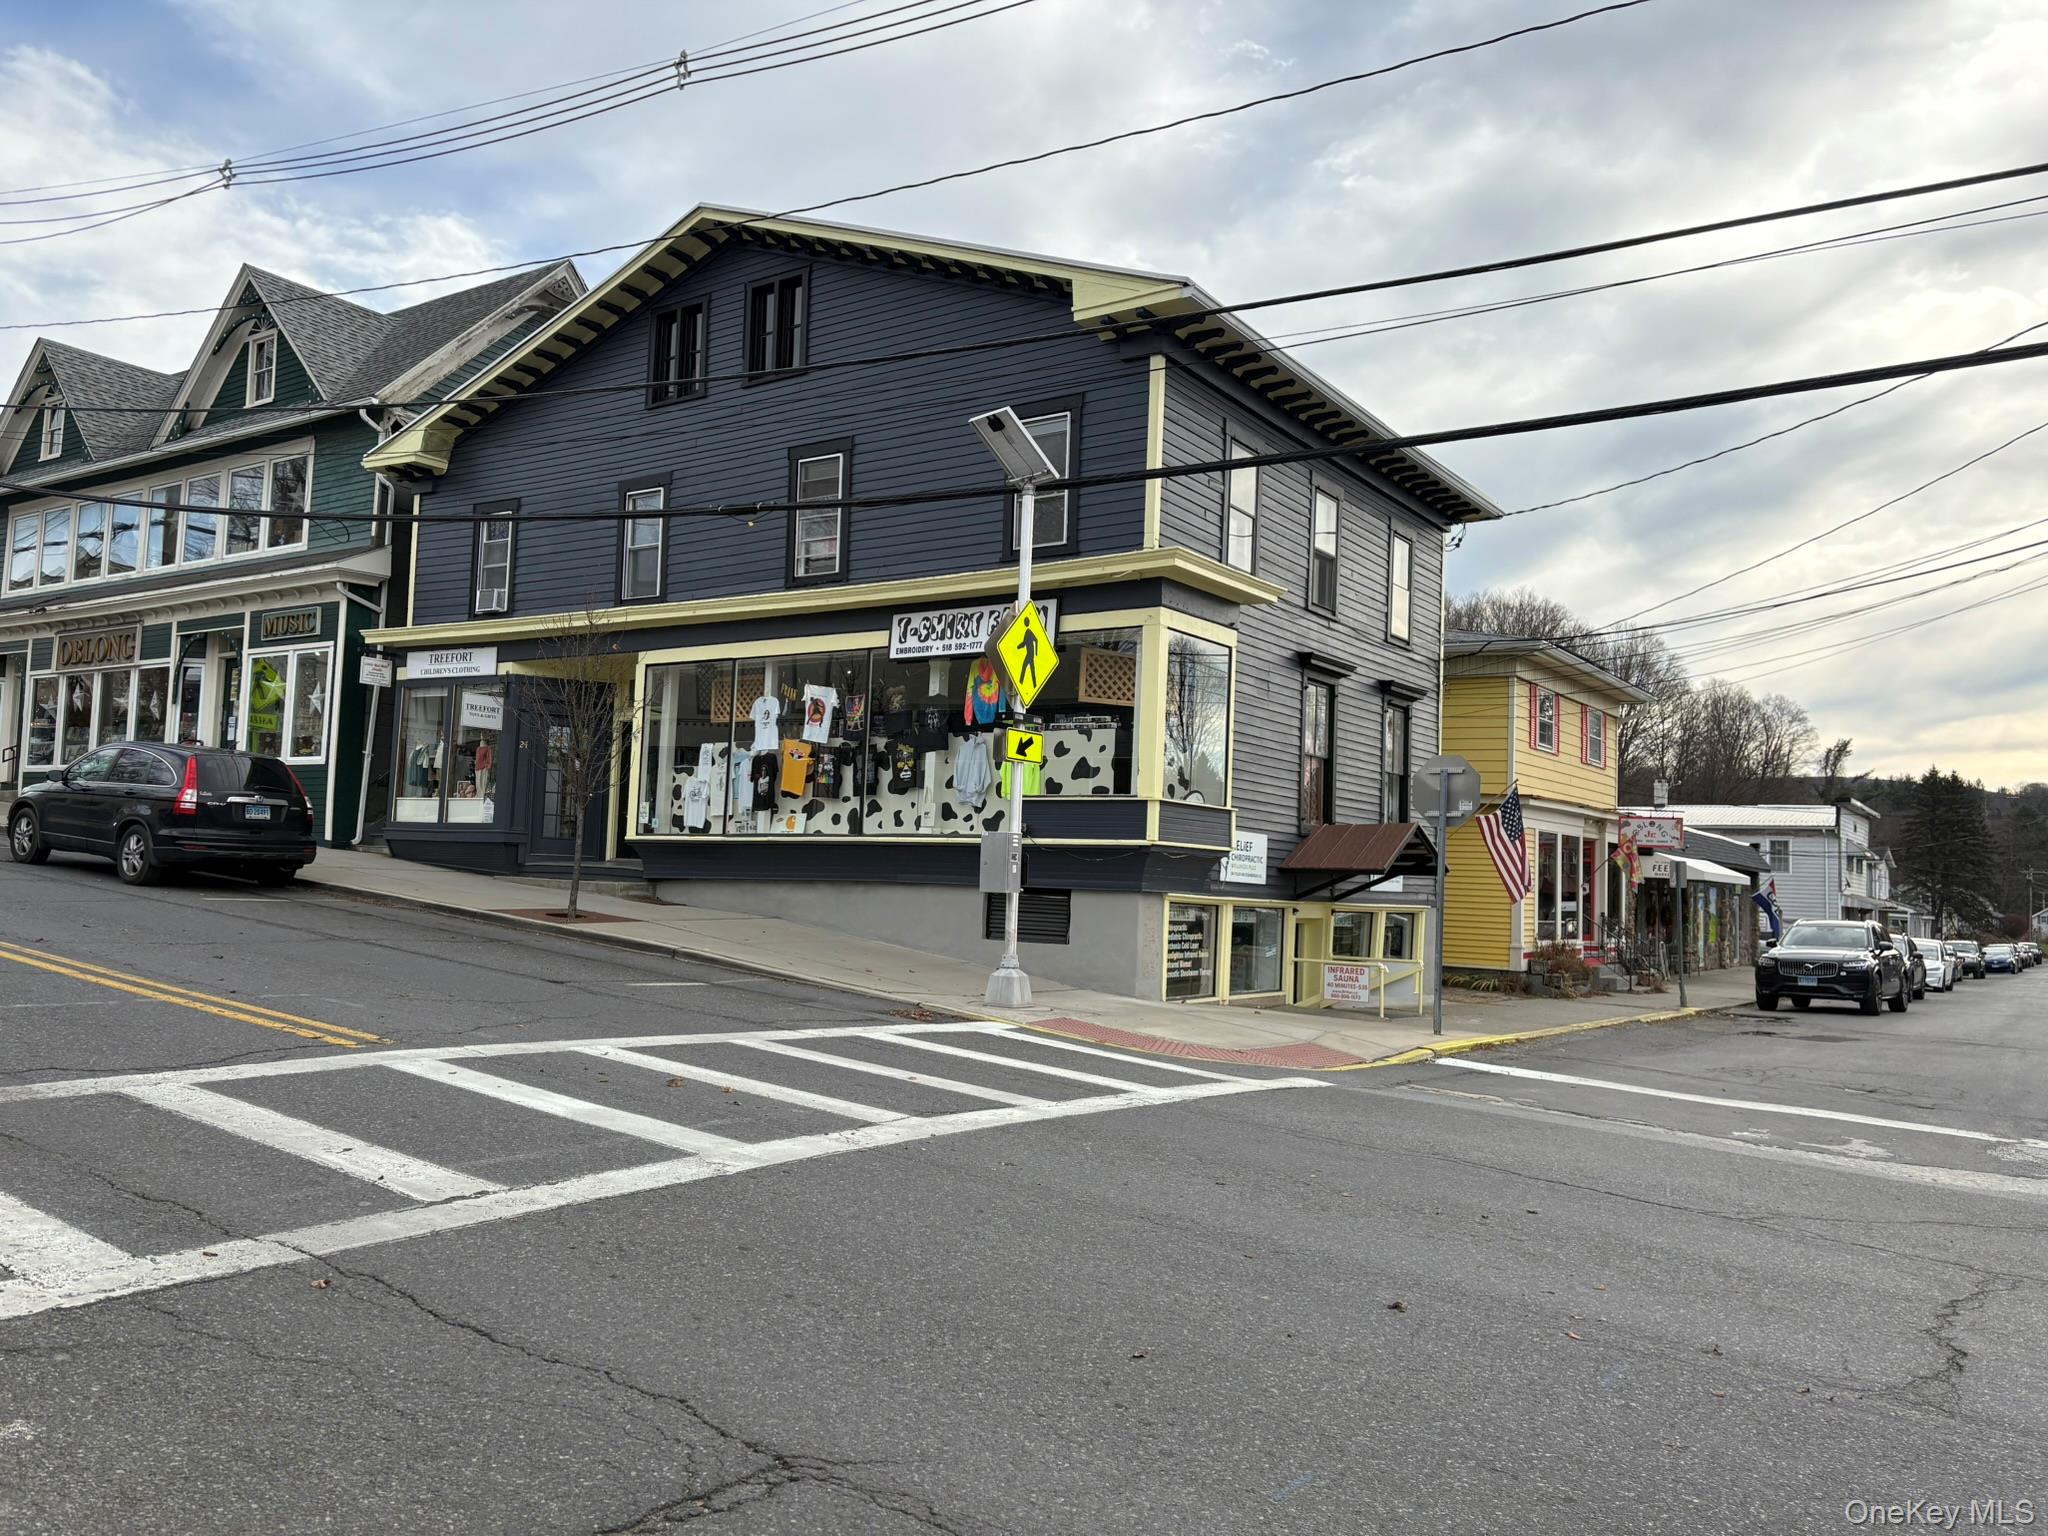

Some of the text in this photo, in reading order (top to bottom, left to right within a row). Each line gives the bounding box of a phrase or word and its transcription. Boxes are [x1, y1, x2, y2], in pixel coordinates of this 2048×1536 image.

[263, 611, 316, 637] MUSIC
[898, 611, 984, 643] T-SHIRT
[59, 632, 136, 666] OBLONG
[895, 644, 934, 655] EMBROIDERY
[954, 641, 983, 651] 592-1777
[429, 651, 474, 664] TREEFORT
[420, 665, 481, 675] CHILDREN'S CLOTHING
[465, 703, 500, 714] TREEFORT
[1231, 853, 1264, 864] CHIROPRACTIC
[1327, 966, 1365, 976] INFRARED
[1333, 974, 1360, 983] SAUNA
